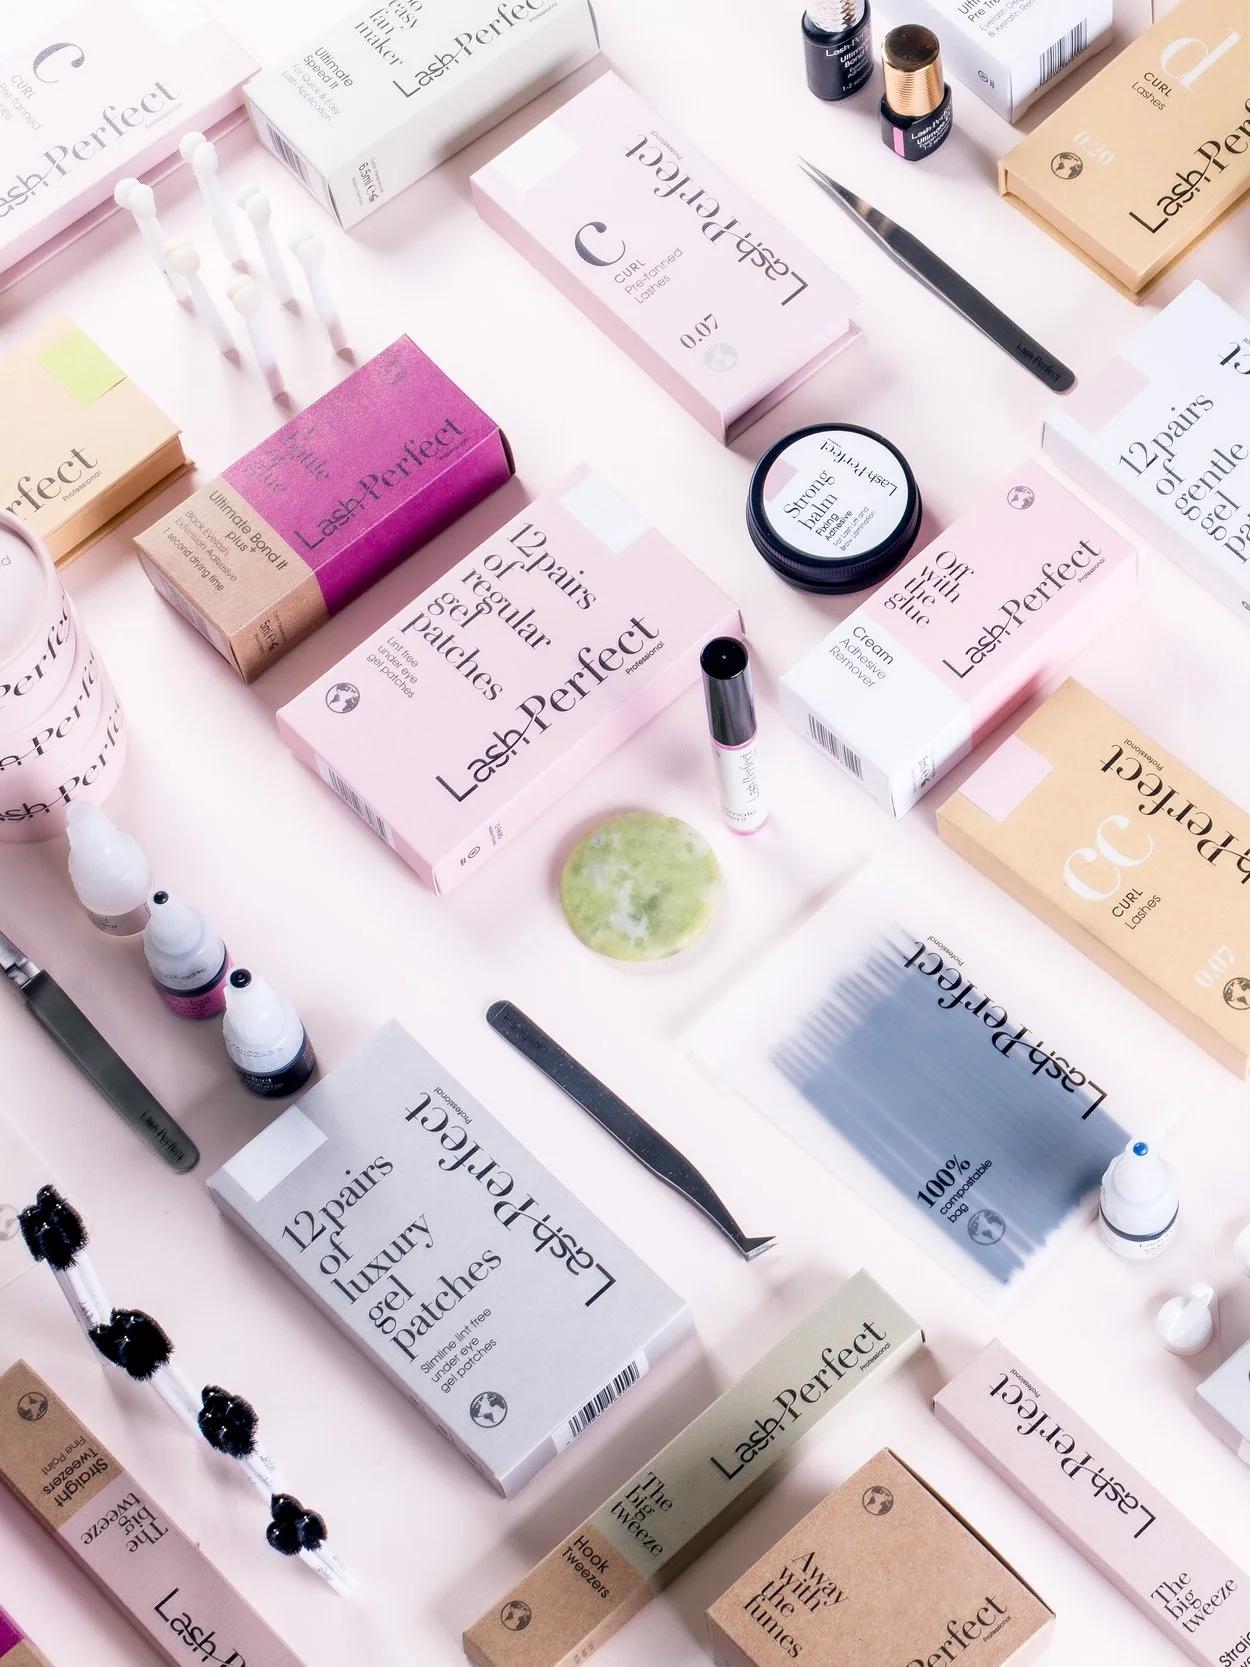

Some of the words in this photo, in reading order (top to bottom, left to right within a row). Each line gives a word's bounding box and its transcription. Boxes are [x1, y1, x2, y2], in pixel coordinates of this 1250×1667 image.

[368, 7, 395, 36] fan
[353, 21, 403, 66] maker
[314, 46, 353, 88] Ultimate
[1143, 71, 1173, 98] CURL
[1131, 81, 1167, 111] Lashes
[1072, 129, 1116, 167] 0.20
[614, 258, 647, 285] CURL
[624, 248, 684, 296] Pre-fanned
[633, 274, 672, 304] Lashes
[679, 313, 720, 350] 0.07
[1154, 458, 1186, 495] of
[1174, 441, 1250, 521] gentle
[815, 512, 839, 537] Fixing
[824, 509, 854, 542] Adhesive
[1200, 492, 1243, 541] gel
[482, 551, 529, 581] of
[934, 550, 975, 581] Off
[427, 589, 490, 631] gel
[459, 567, 551, 650] regular
[904, 578, 936, 609] the
[398, 609, 505, 701] patches
[838, 637, 888, 680] Adhesive
[852, 627, 895, 666] Cream
[366, 651, 386, 671] gel
[384, 665, 415, 699] patches
[828, 646, 877, 689] Remover
[1111, 887, 1143, 918] CURL
[1123, 894, 1162, 930] Lashes
[917, 1153, 972, 1208] 100%
[939, 1158, 994, 1215] compostable
[947, 1202, 970, 1224] bag
[319, 1225, 354, 1275] of
[330, 1212, 433, 1305] luxury
[368, 1274, 417, 1334] gel
[389, 1247, 504, 1364] patches
[41, 1451, 66, 1475] Point
[64, 1434, 87, 1455] Fine
[42, 1446, 99, 1496] Tweezers
[53, 1458, 109, 1507] Straight
[625, 1483, 658, 1522] big
[639, 1471, 674, 1513] The
[80, 1491, 141, 1545] tweeze
[124, 1504, 158, 1535] big
[125, 1520, 170, 1553] The
[561, 1546, 610, 1600] Tweezers
[572, 1534, 611, 1575] Hook
[1163, 1589, 1203, 1621] big
[1182, 1575, 1239, 1635] tweeze
[743, 1593, 803, 1659] fumes
